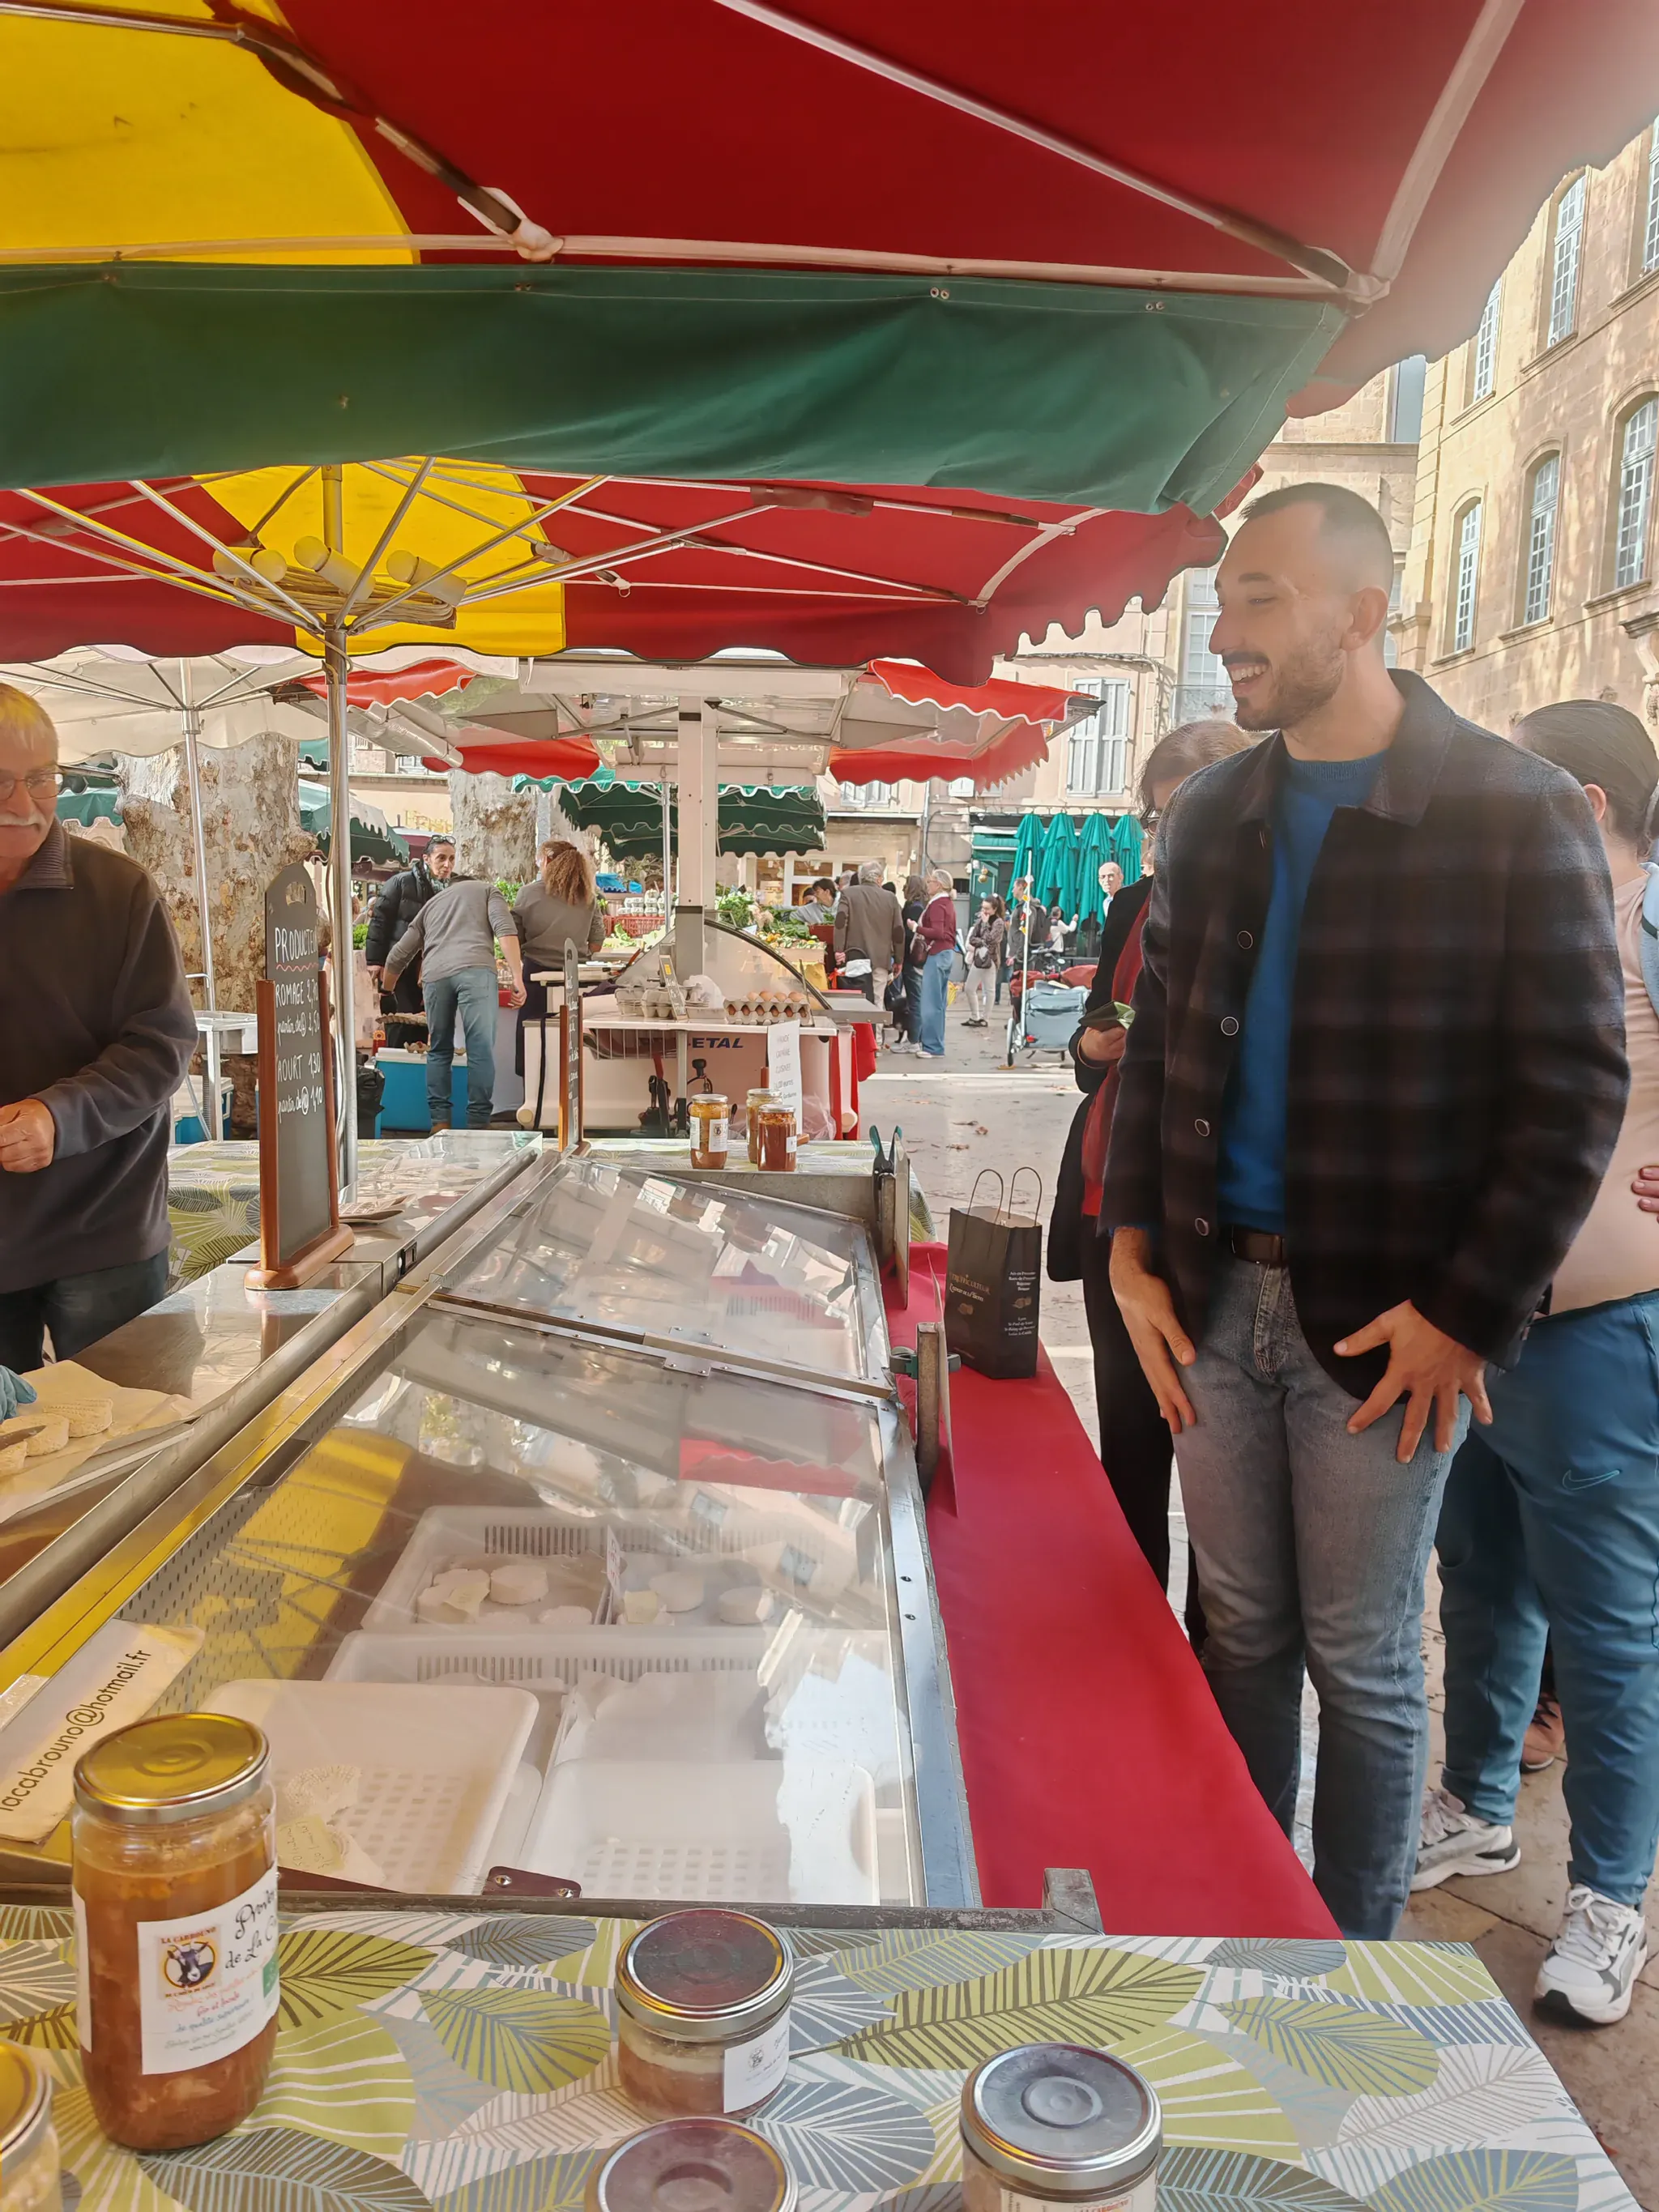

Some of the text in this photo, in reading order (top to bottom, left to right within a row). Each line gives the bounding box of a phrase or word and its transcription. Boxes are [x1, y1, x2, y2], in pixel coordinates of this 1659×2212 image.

[275, 981, 305, 1008] ROMAGE
[275, 1054, 303, 1082] AOURT
[0, 1649, 152, 1812] lacabrouno@hotmail.fr
